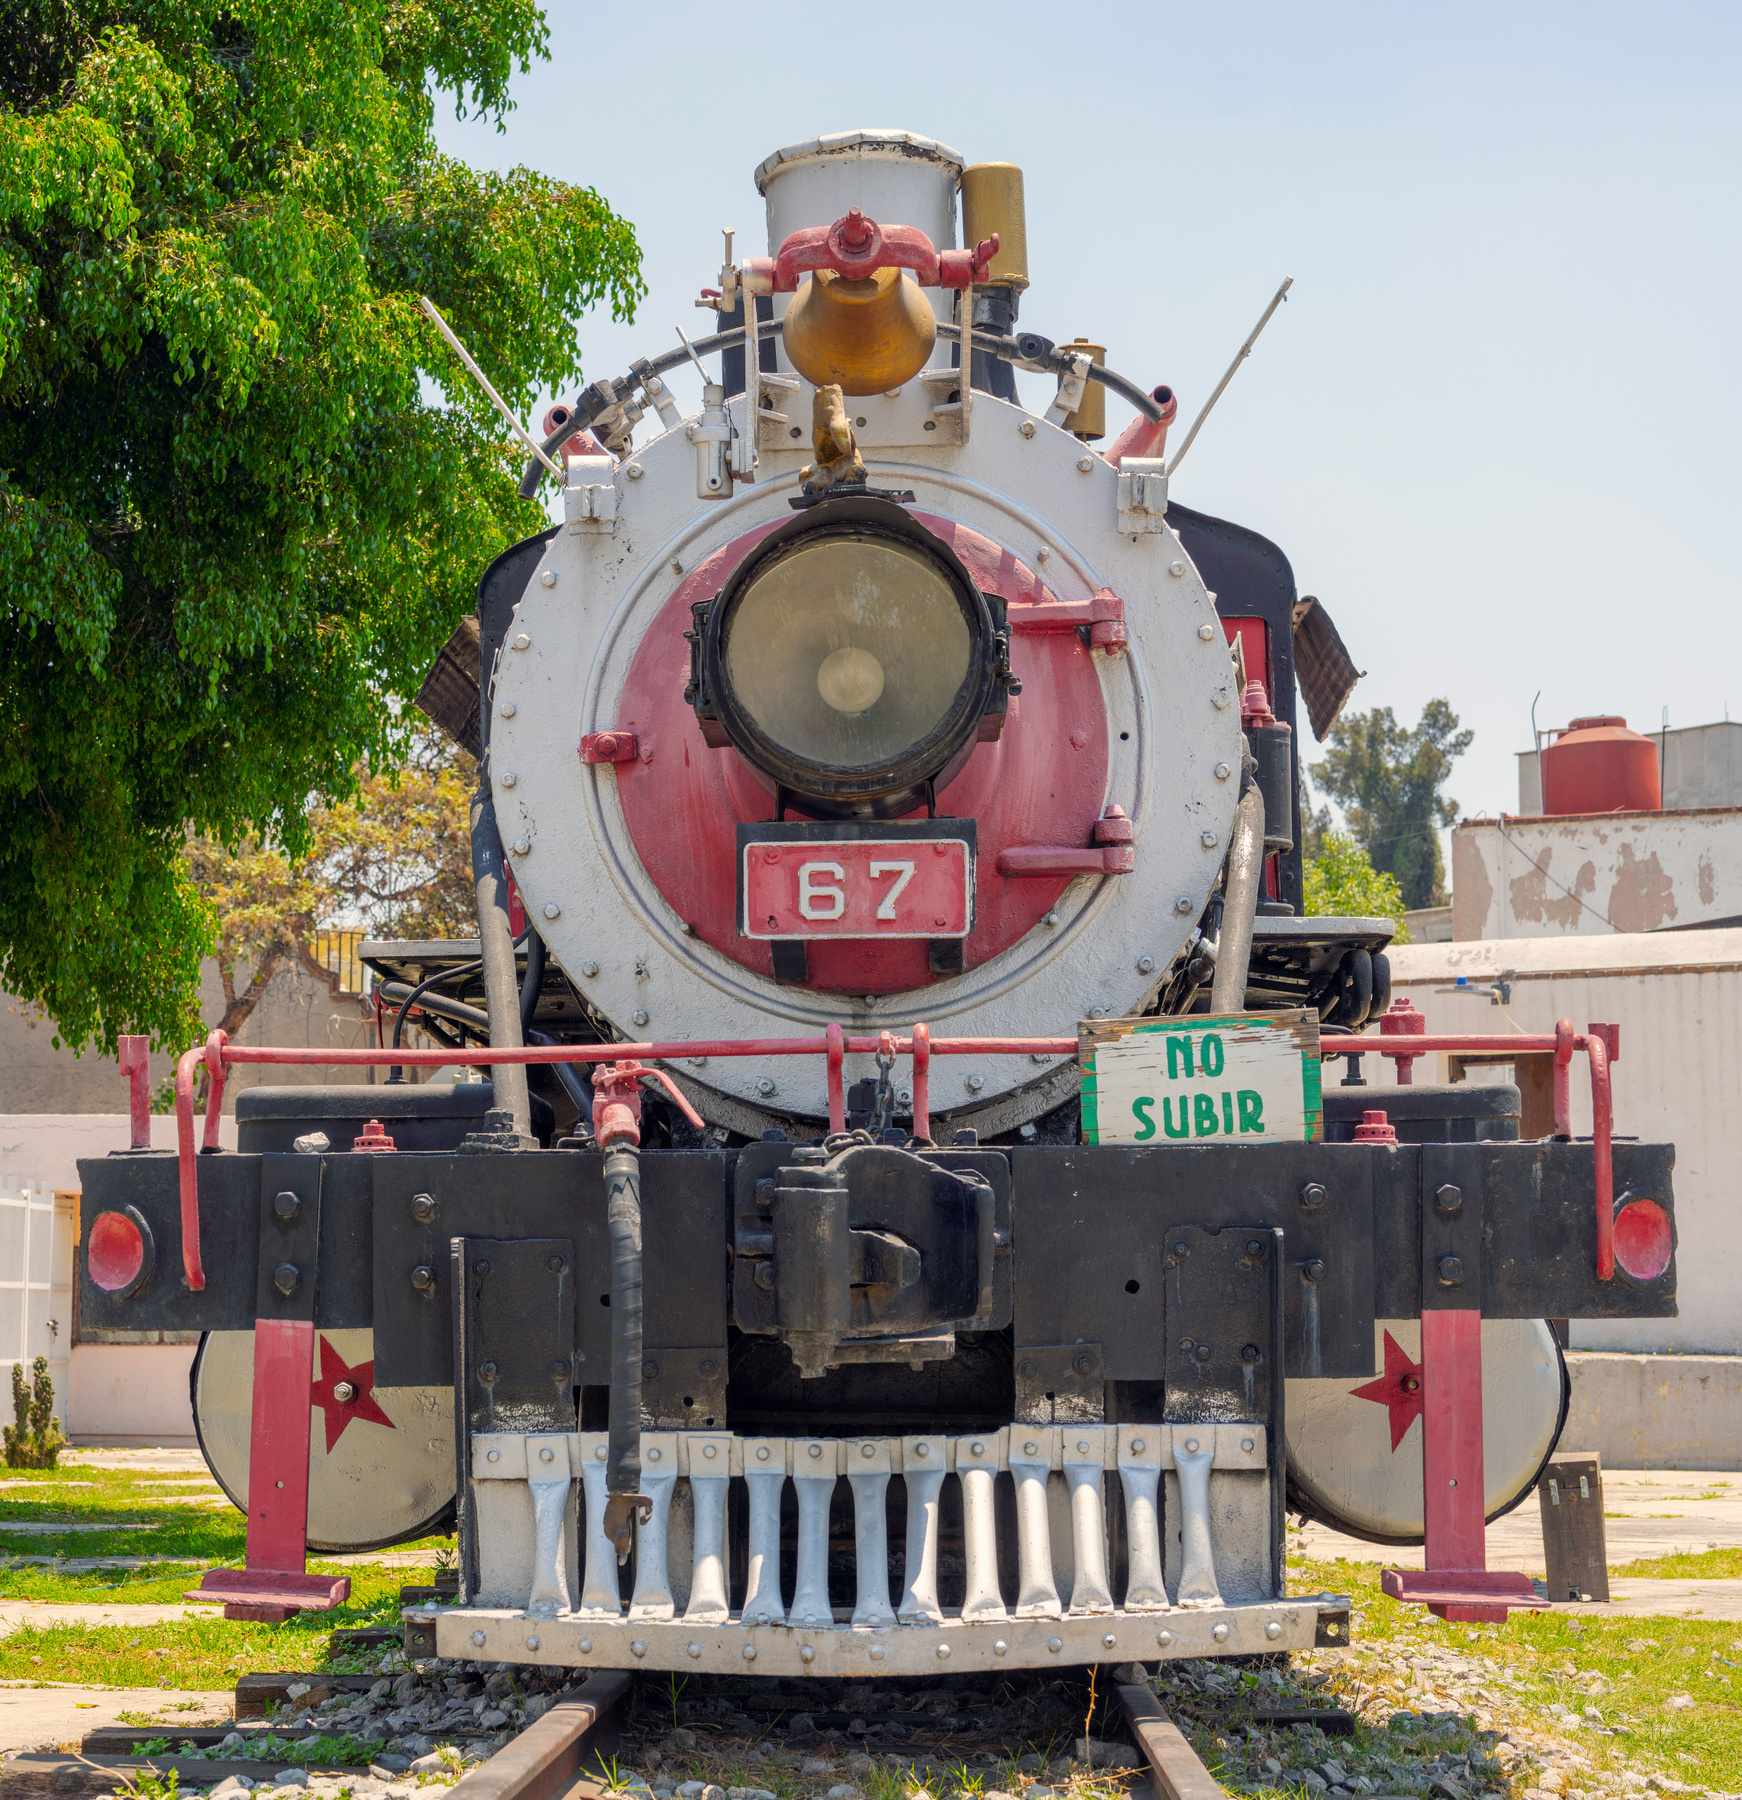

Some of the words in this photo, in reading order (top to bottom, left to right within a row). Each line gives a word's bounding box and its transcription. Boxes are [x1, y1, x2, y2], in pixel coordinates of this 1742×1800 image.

[798, 861, 916, 920] 67
[1166, 1033, 1224, 1079] NO
[1132, 1089, 1265, 1140] SUBIR
